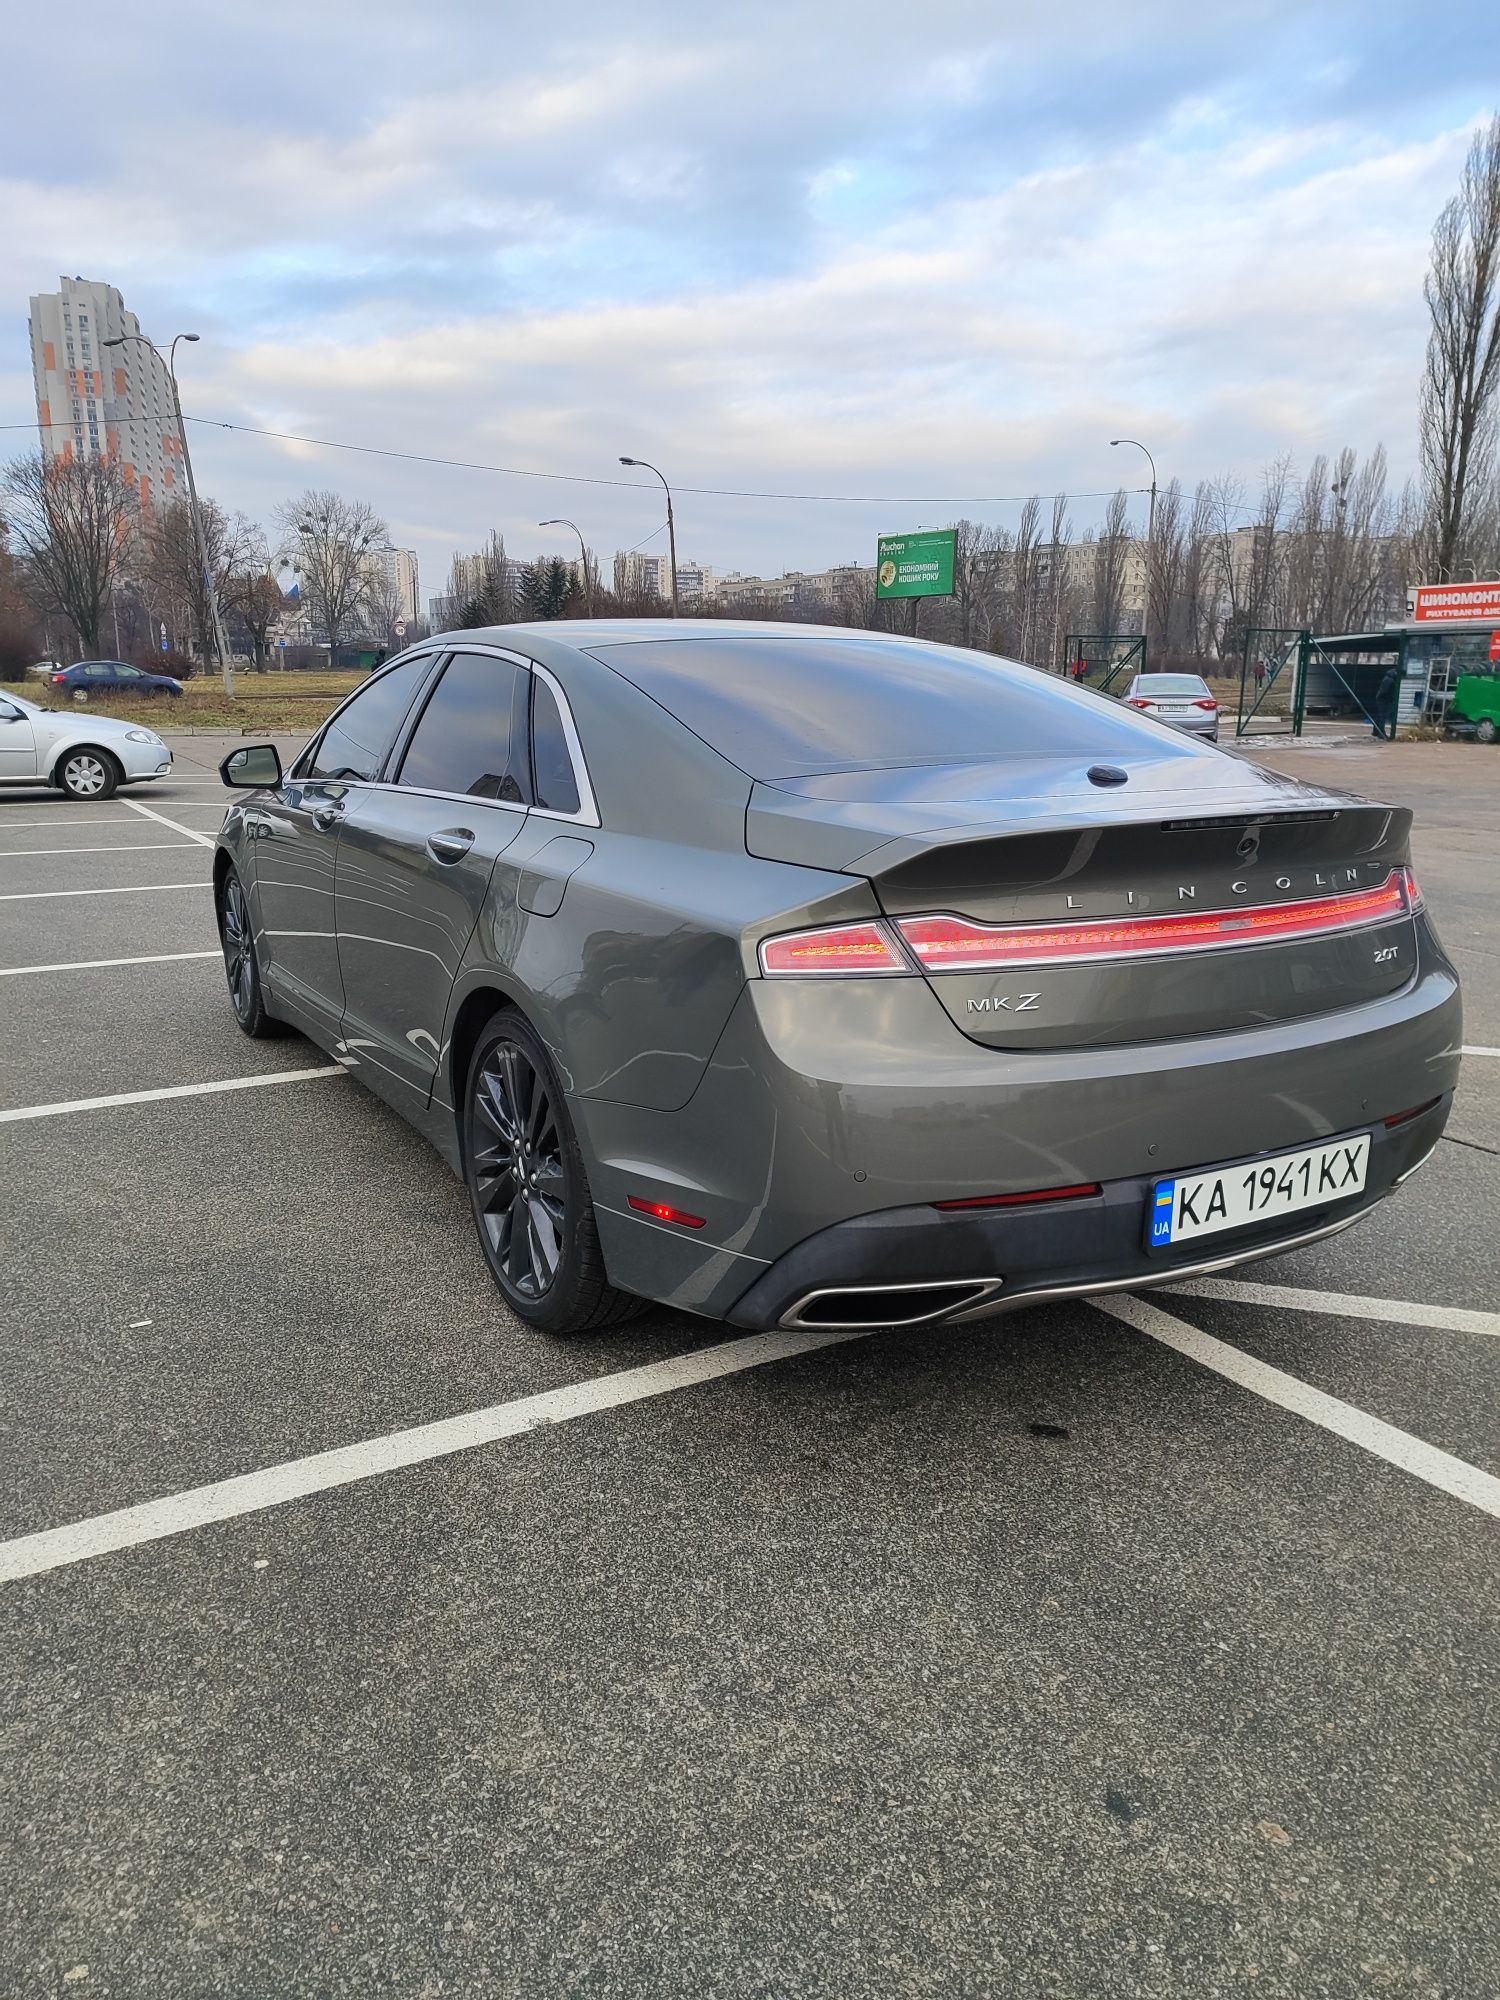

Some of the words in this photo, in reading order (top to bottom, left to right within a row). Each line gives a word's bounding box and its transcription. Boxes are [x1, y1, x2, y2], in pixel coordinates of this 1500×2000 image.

[880, 541, 905, 551] Auchan
[899, 573, 921, 582] КОШИК
[922, 572, 939, 581] РОКУ
[1421, 590, 1500, 606] ШИНОМОНТ
[1066, 867, 1358, 909] LINCOLN
[966, 991, 1042, 1014] MKZ
[1178, 1179, 1228, 1230] KA
[1154, 1221, 1170, 1236] UA
